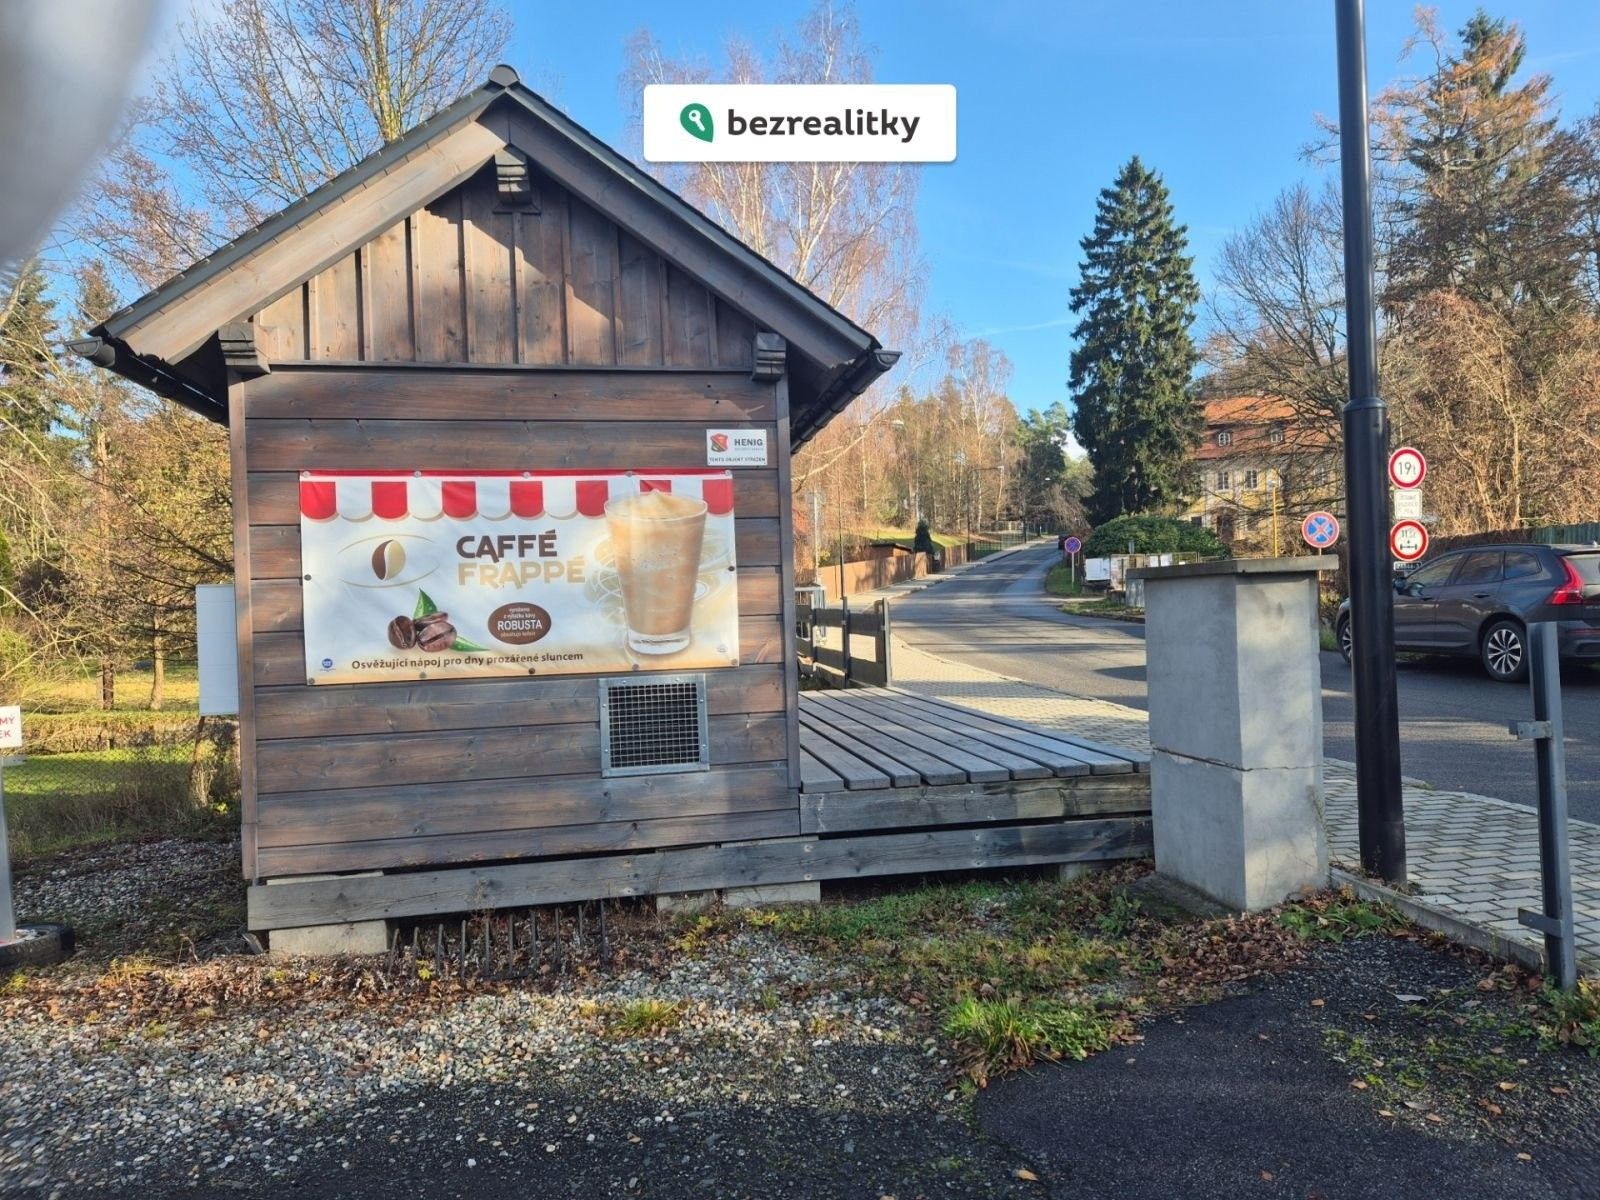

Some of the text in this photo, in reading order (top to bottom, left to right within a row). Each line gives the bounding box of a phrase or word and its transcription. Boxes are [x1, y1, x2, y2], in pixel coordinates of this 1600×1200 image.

[734, 438, 763, 446] HENIG
[456, 529, 558, 563] CAFFÉ
[458, 556, 586, 590] FRAPPÉ
[497, 619, 543, 631] ROBUSTA
[352, 653, 583, 670] Osvěžující nápoj pro dny prozářené sluncem
